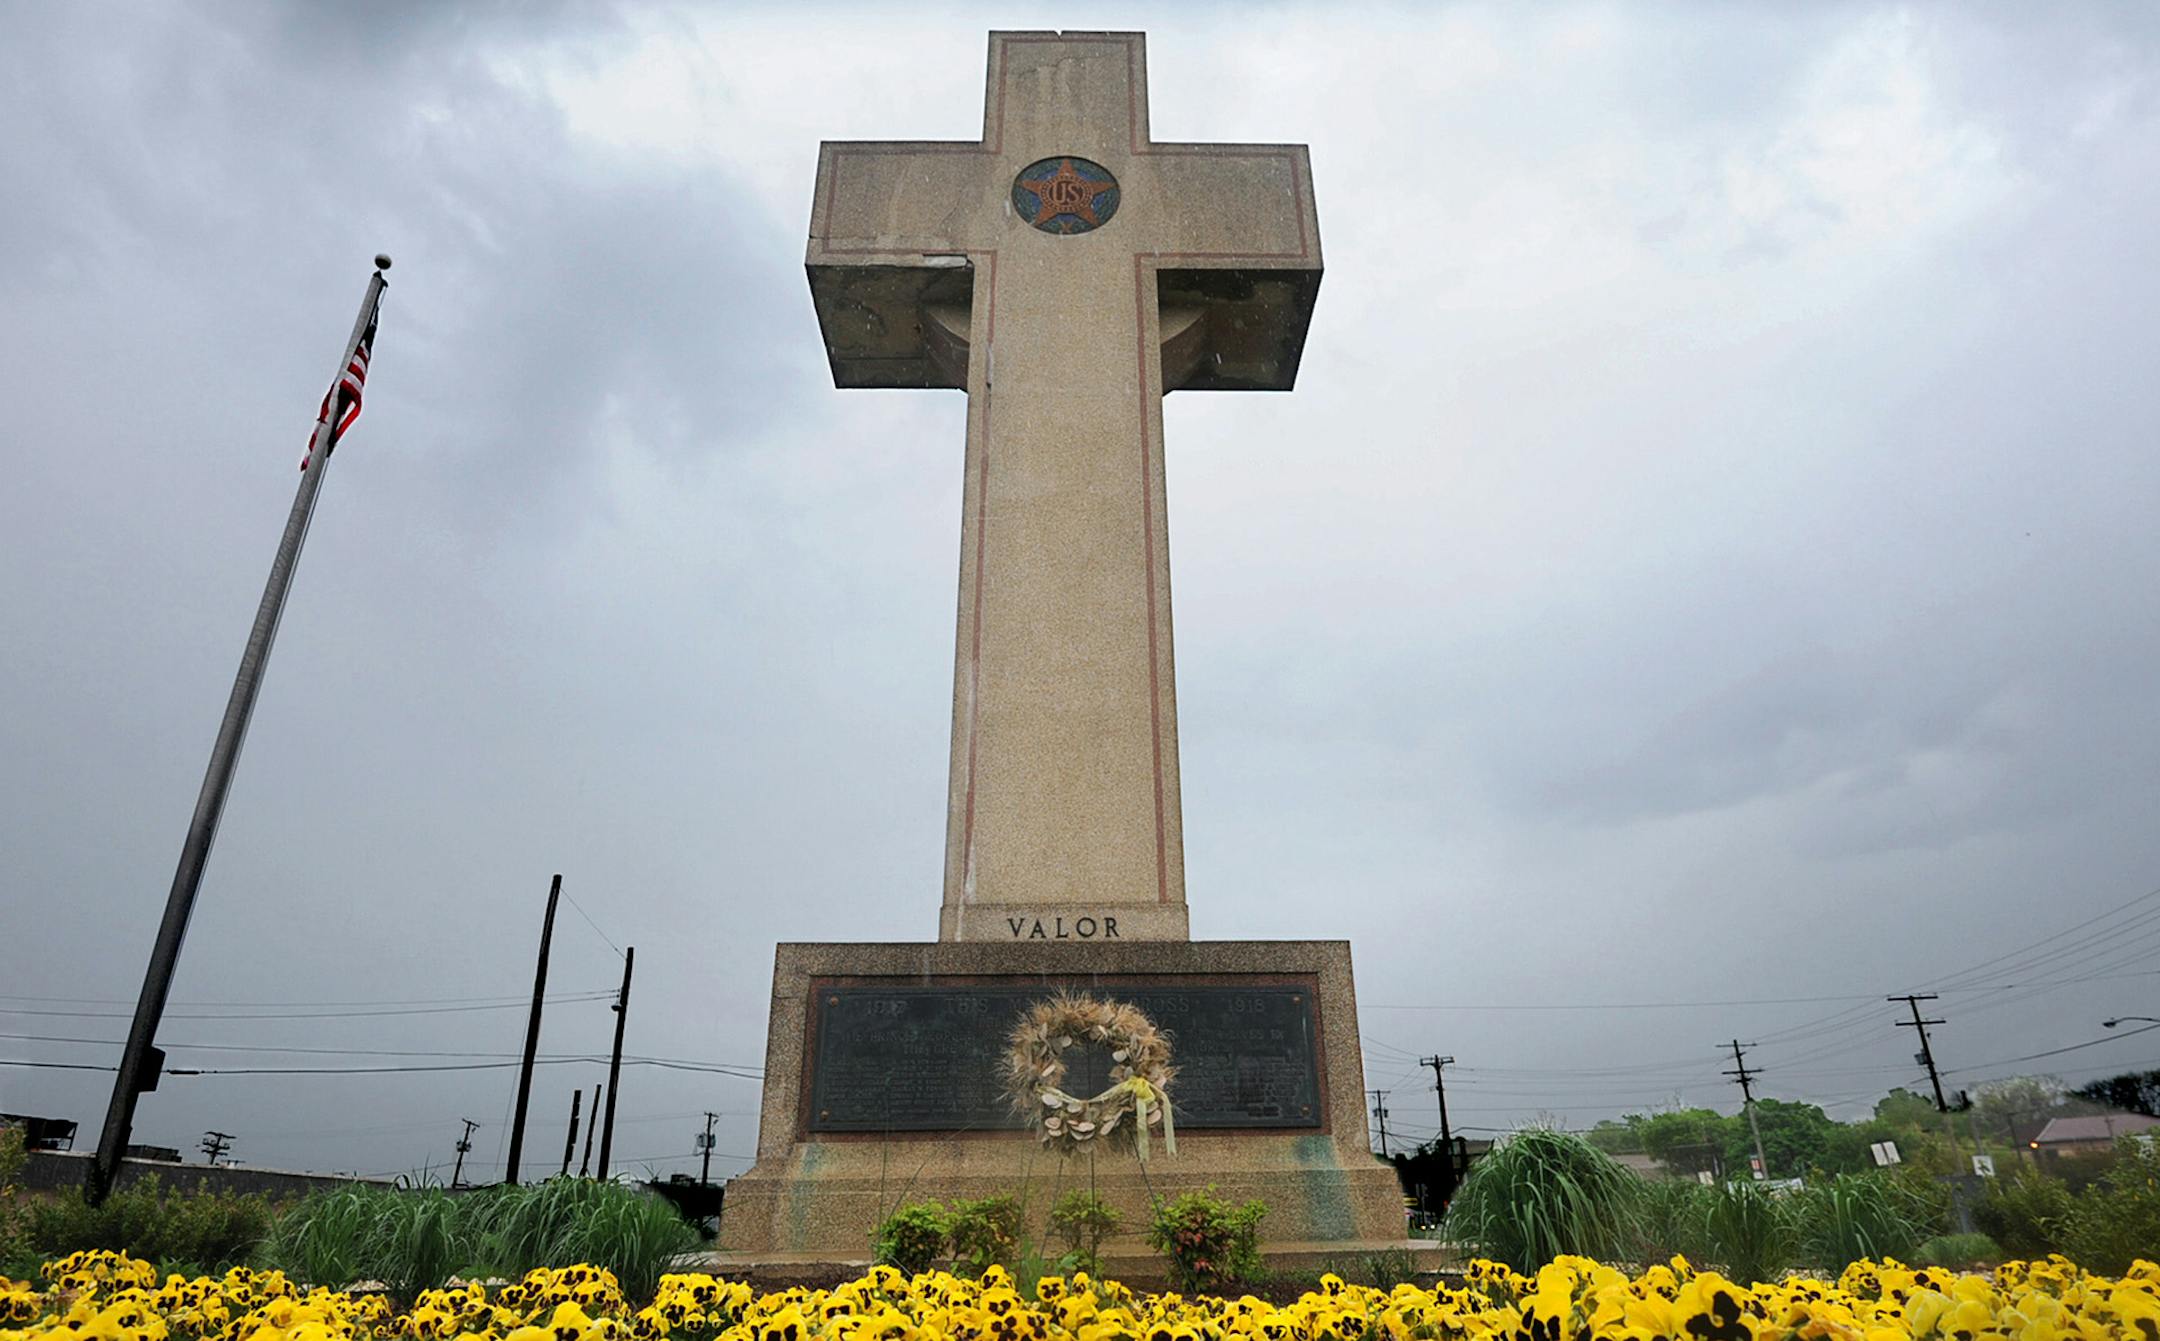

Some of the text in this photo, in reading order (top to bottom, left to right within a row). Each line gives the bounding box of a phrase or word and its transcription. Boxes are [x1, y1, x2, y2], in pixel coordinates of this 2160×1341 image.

[1007, 917, 1119, 938] VALOR
[1134, 997, 1190, 1013] ROSS
[1228, 998, 1266, 1013] 1918
